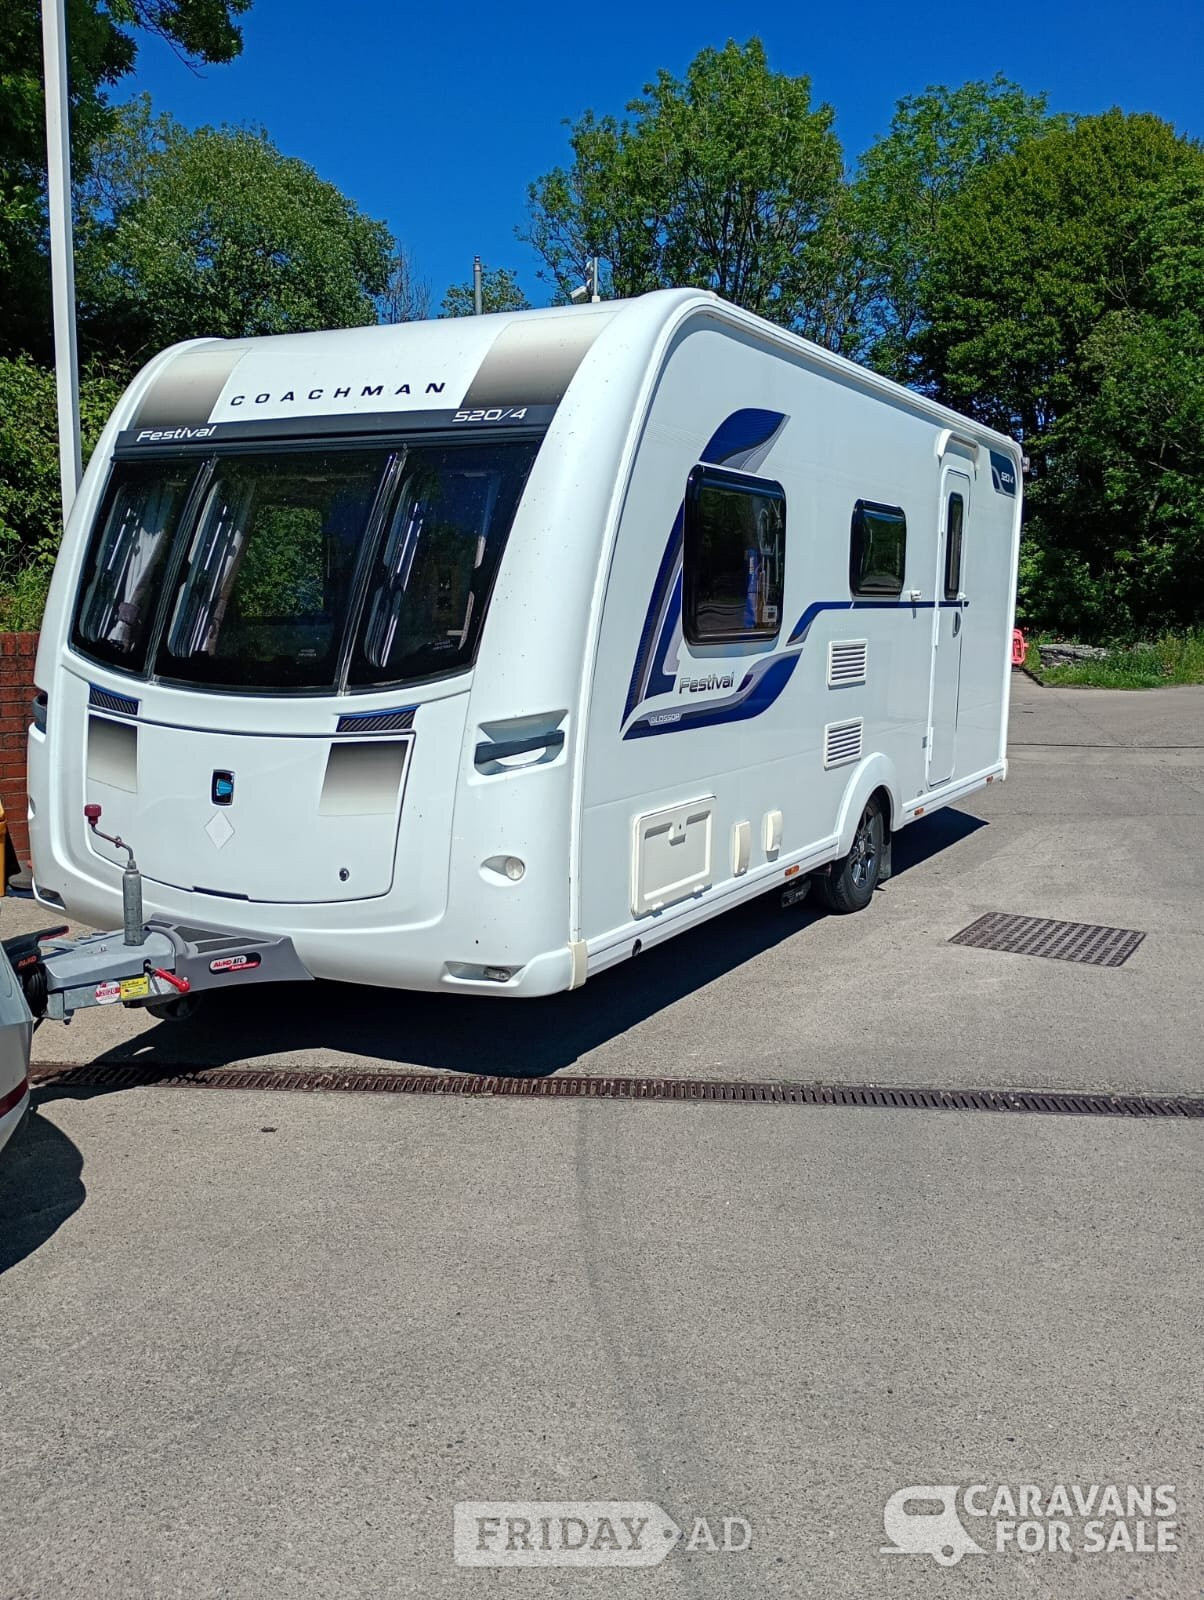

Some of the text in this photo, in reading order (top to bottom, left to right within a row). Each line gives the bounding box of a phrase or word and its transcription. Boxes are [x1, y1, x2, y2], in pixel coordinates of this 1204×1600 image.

[230, 382, 446, 406] COACHMAN
[452, 408, 528, 422] 520/4
[135, 426, 217, 442] Festival
[678, 672, 734, 694] Festival
